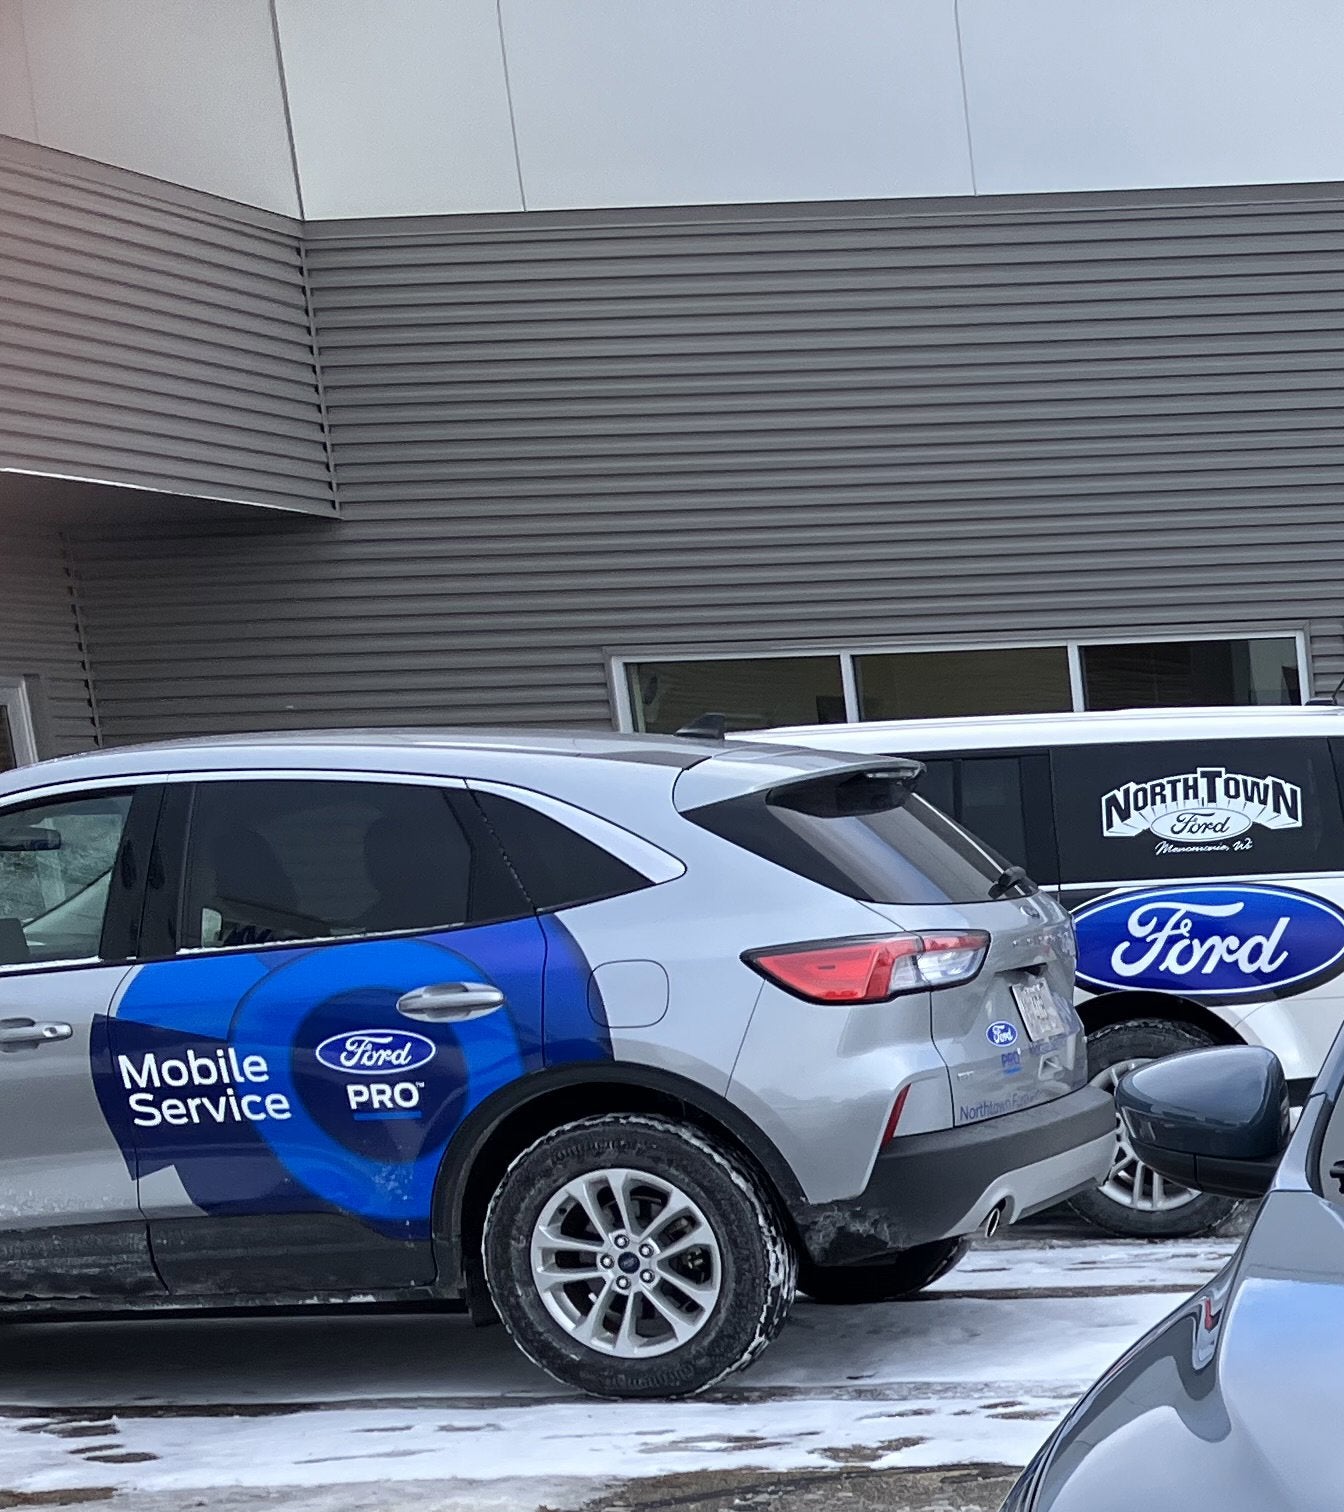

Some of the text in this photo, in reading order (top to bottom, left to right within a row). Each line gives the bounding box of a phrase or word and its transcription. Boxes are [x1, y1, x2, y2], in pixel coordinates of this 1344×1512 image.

[1171, 812, 1230, 835] Ford
[1110, 901, 1290, 977] Ford
[340, 1035, 412, 1068] Ford
[992, 1024, 1014, 1044] Ford
[117, 1047, 270, 1089] Mobile
[128, 1087, 293, 1127] Service
